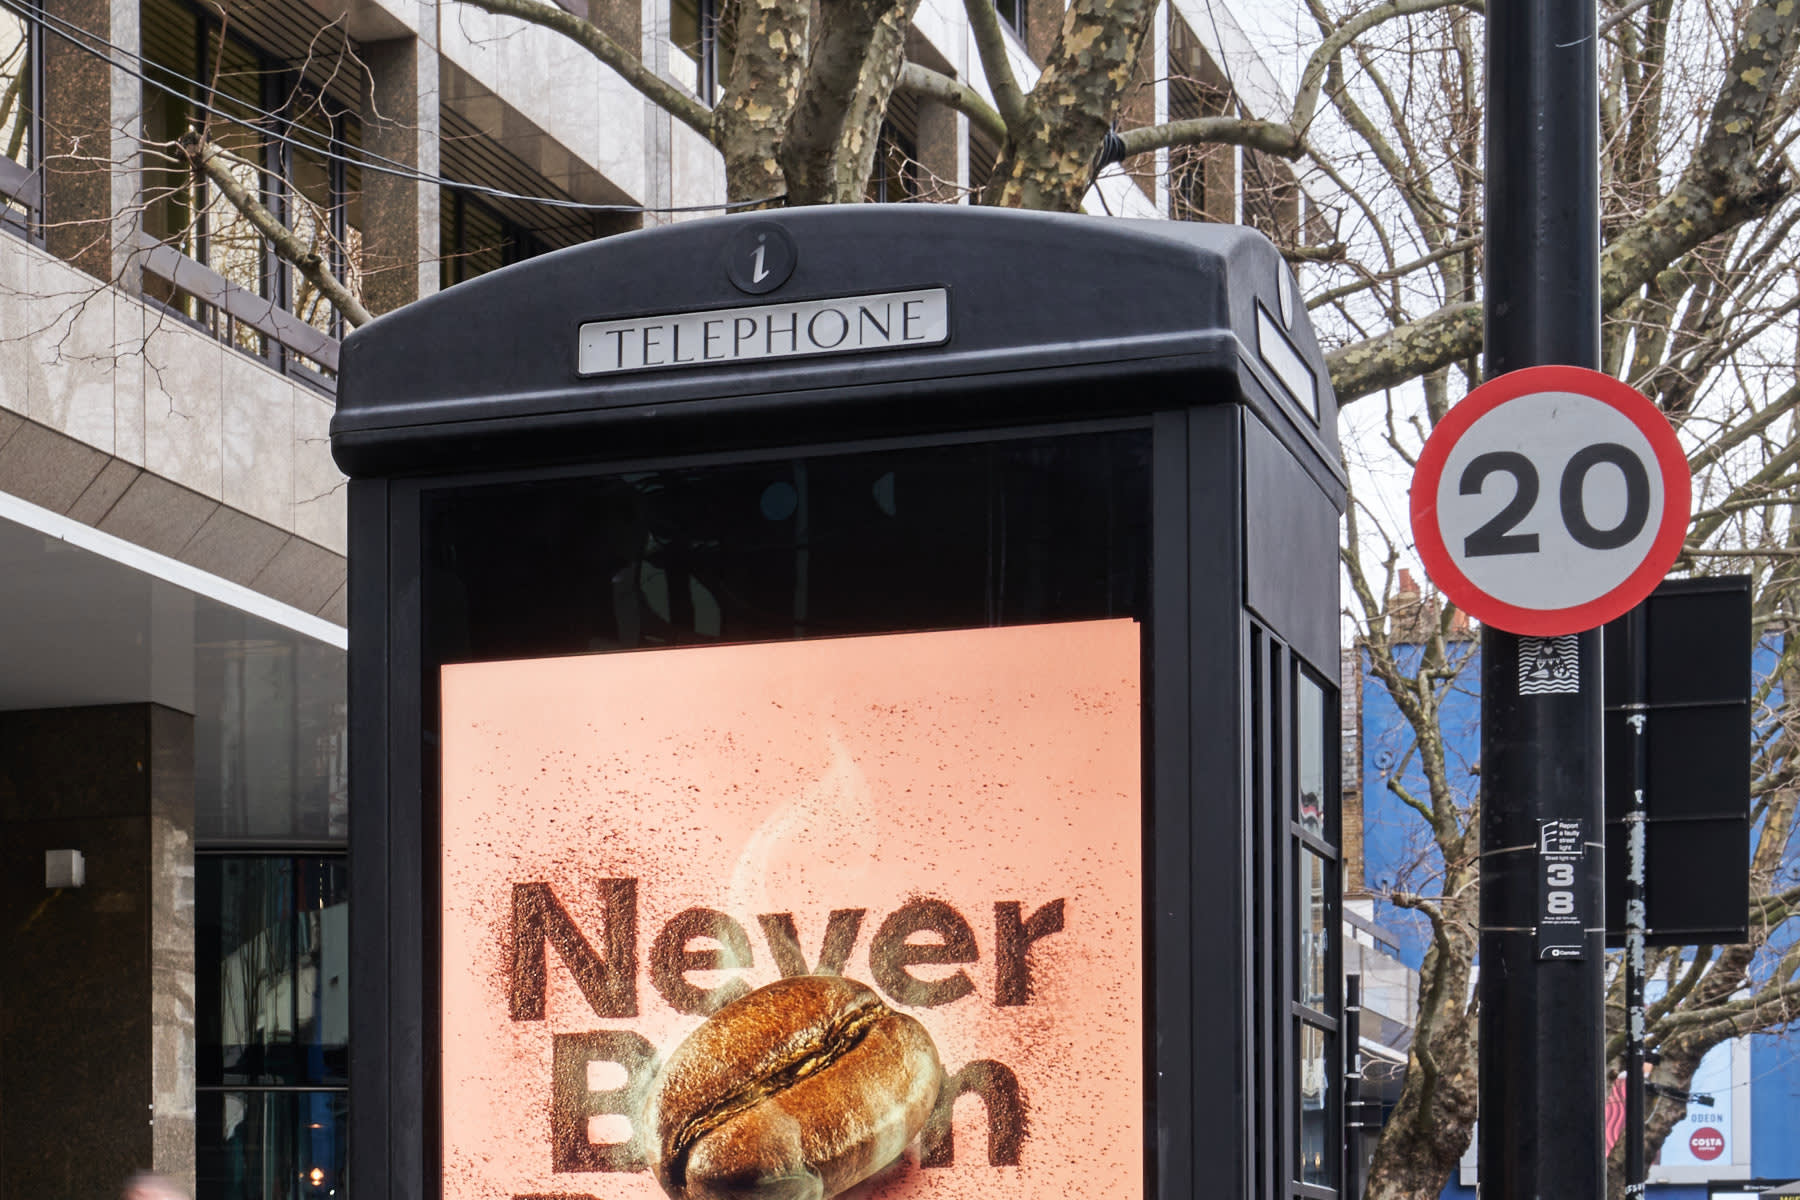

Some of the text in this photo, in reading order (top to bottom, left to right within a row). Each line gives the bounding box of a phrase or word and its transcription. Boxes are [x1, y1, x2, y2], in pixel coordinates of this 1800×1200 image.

[605, 299, 926, 368] TELEPHONE
[1458, 442, 1650, 557] 20
[1547, 864, 1574, 886] 3
[1547, 891, 1574, 914] 8
[506, 877, 1066, 1021] Never
[550, 1028, 1028, 1174] Bn
[1690, 1113, 1723, 1122] ODEON
[1691, 1137, 1722, 1147] COSTA
